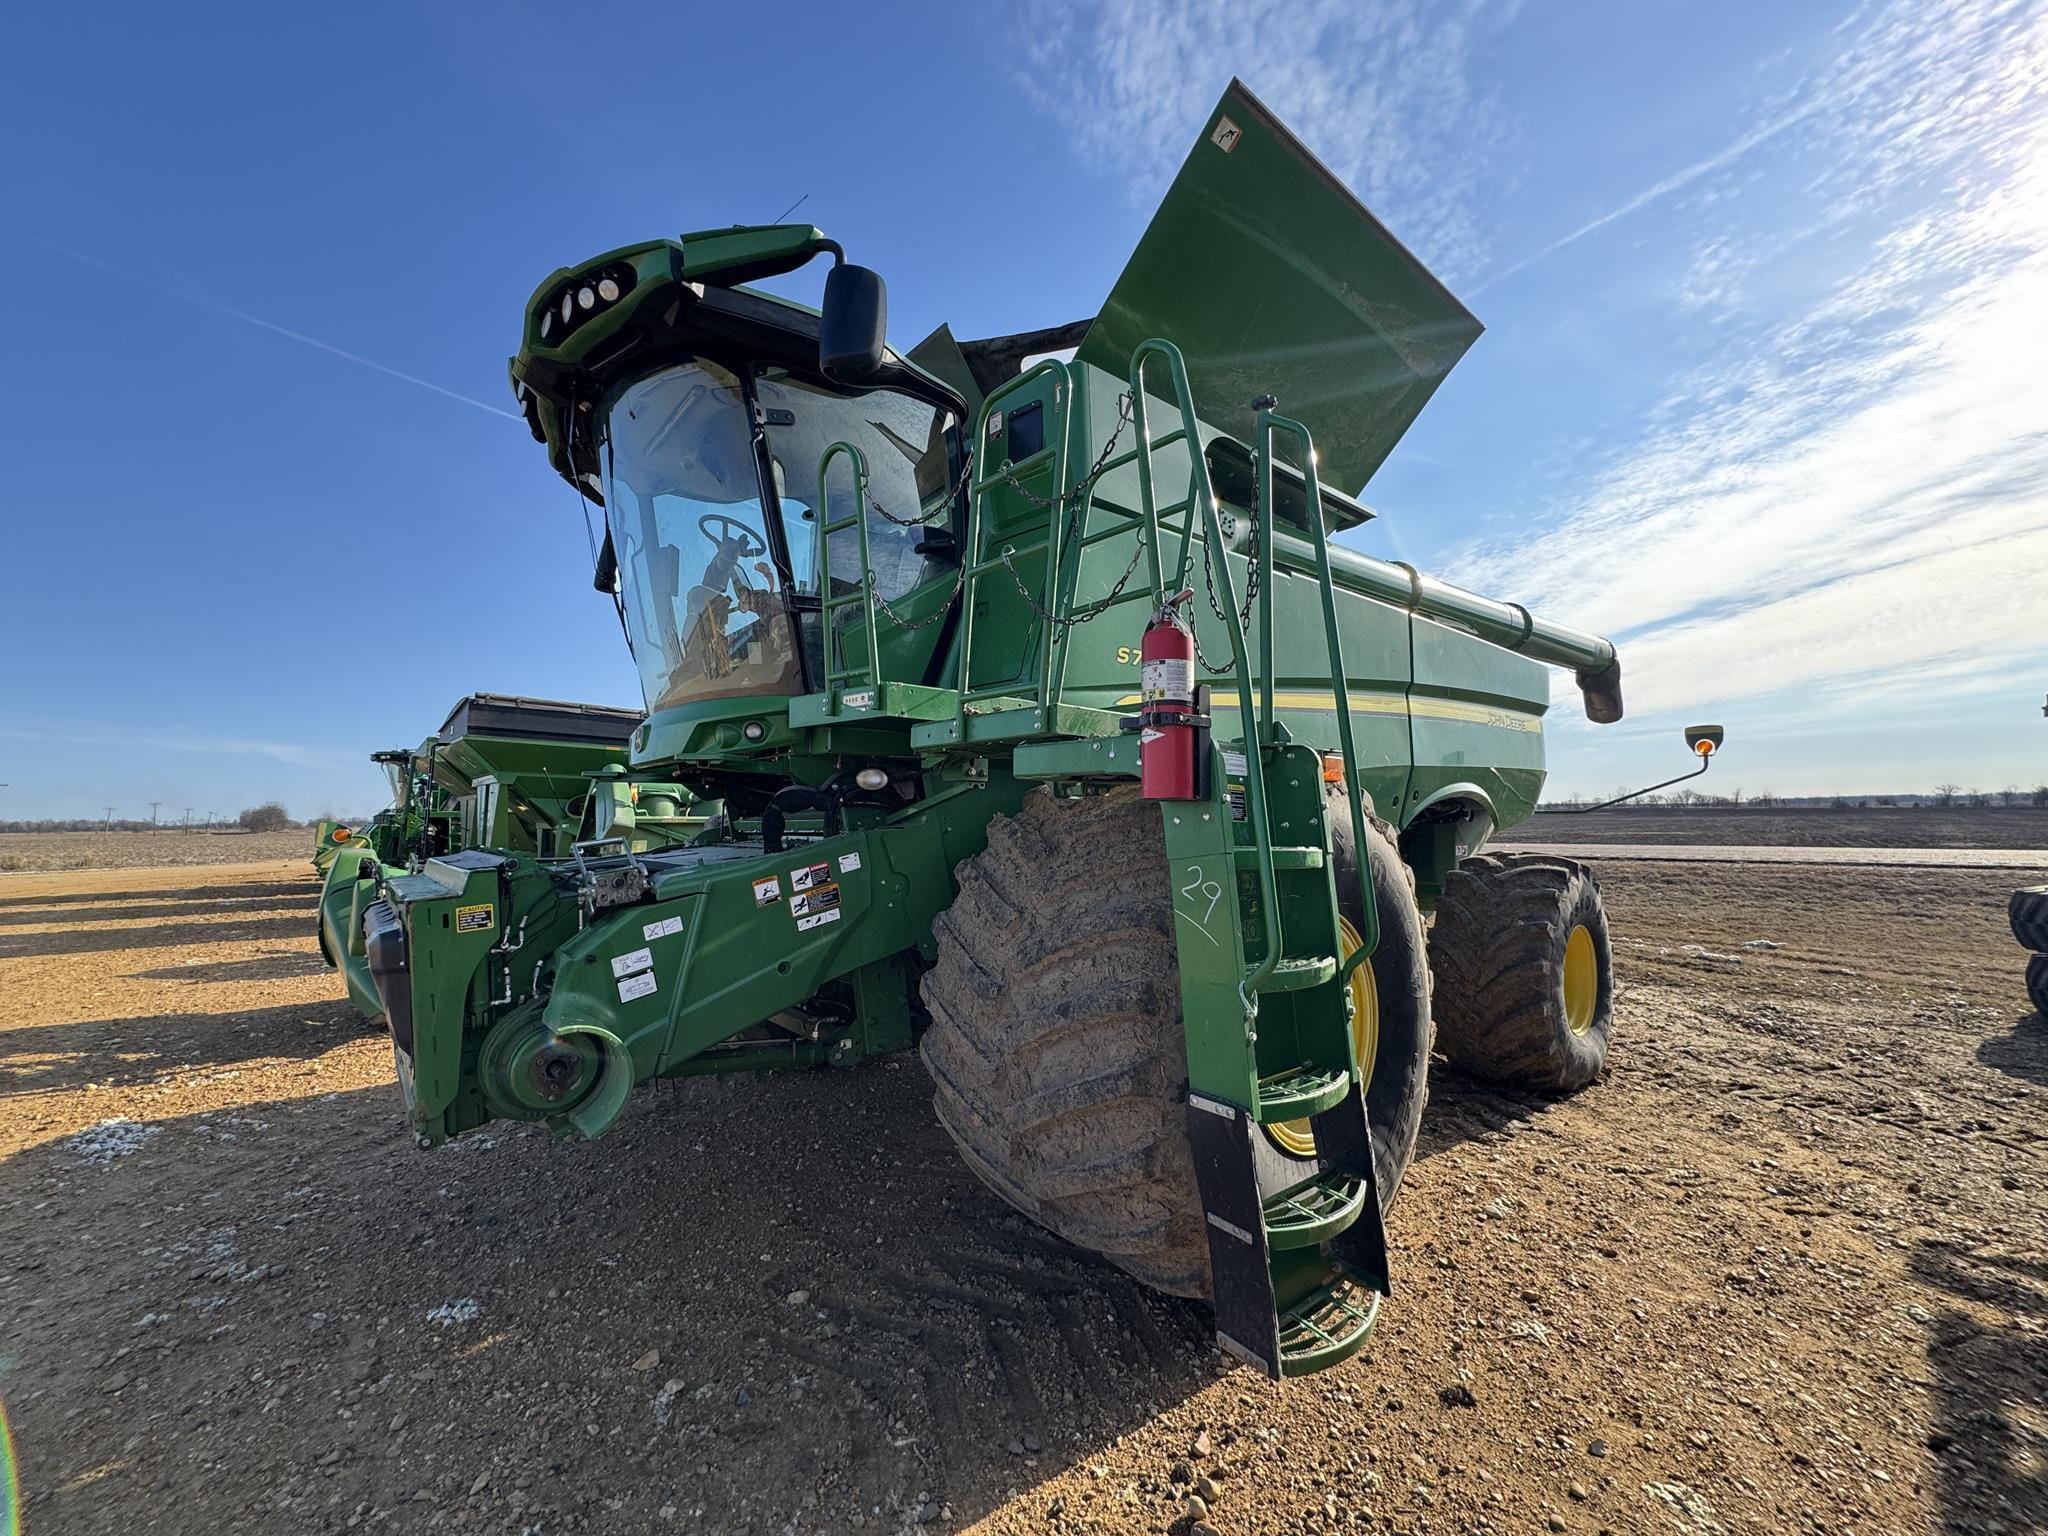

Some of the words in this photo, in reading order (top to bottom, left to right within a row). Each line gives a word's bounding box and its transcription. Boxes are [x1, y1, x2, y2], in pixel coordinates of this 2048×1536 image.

[1487, 711, 1504, 726] JOHN
[1504, 714, 1527, 731] DEERE
[1181, 865, 1222, 924] 29
[463, 904, 492, 913] CAUTION
